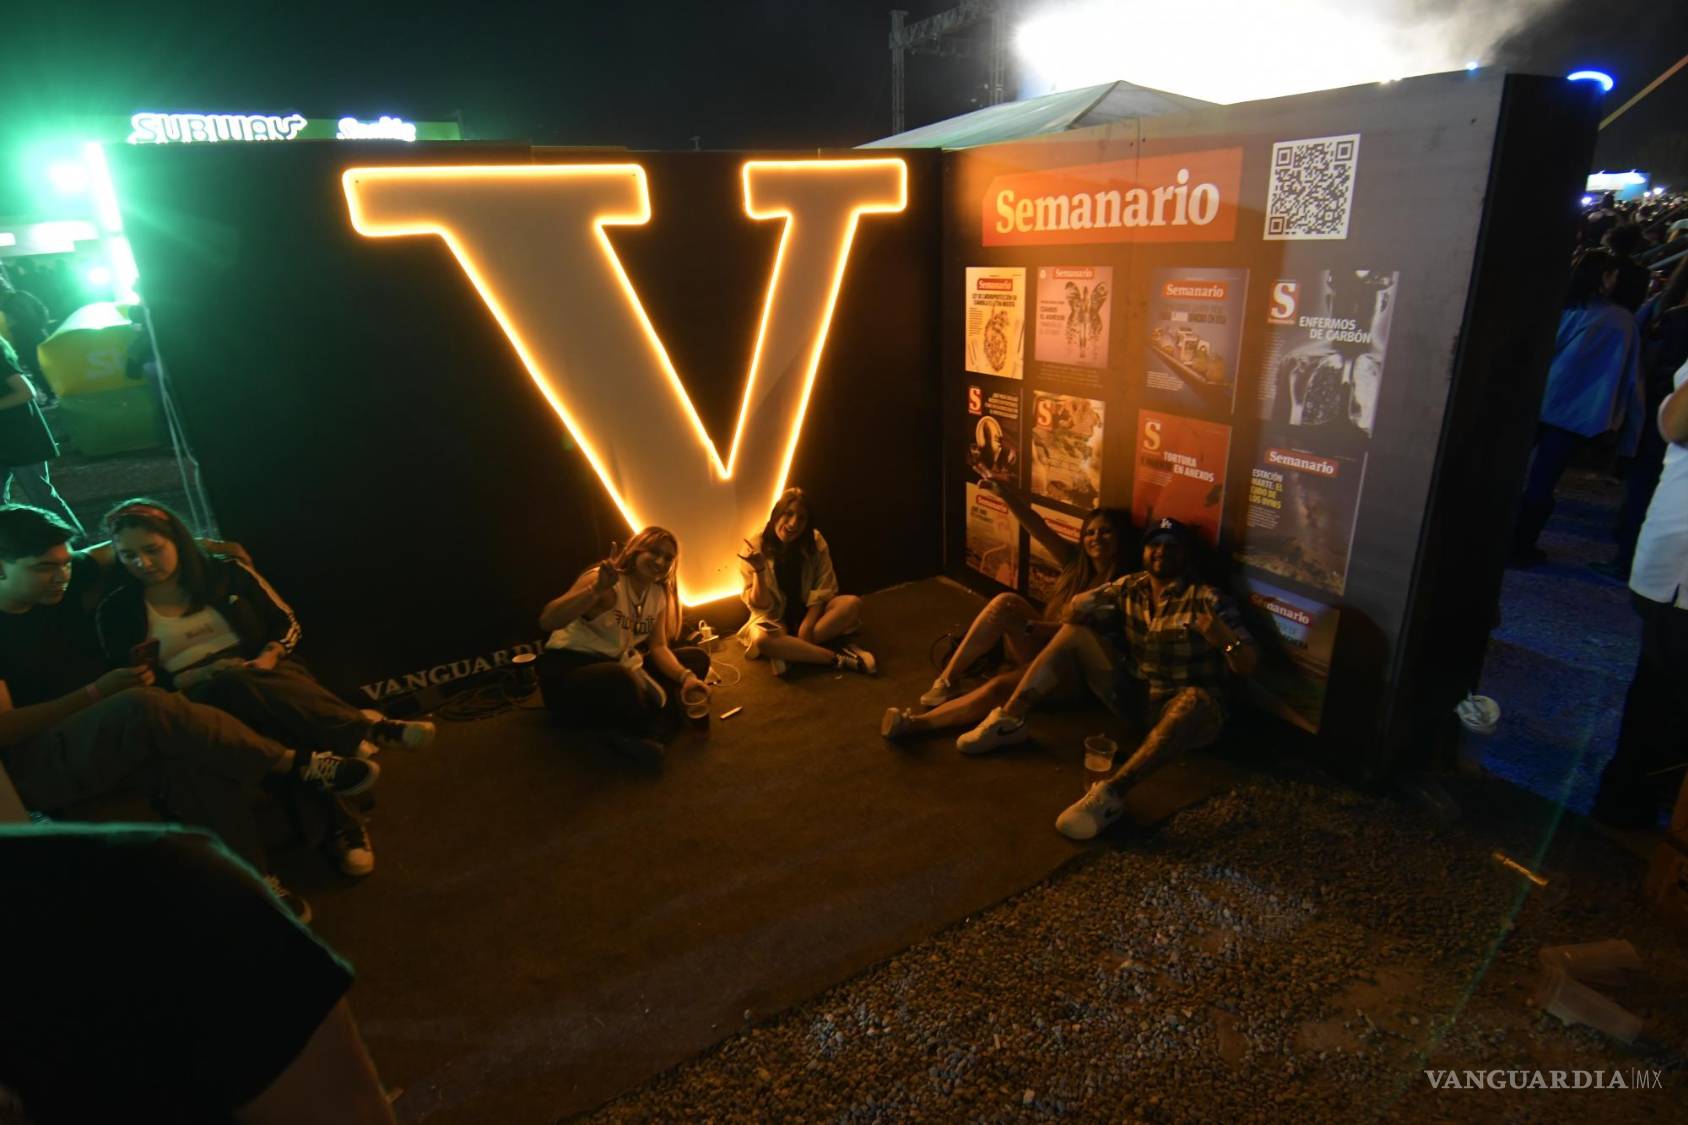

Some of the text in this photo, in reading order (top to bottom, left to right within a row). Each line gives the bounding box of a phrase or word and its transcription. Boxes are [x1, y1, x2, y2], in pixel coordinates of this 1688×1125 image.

[128, 112, 308, 144] SUBWAY
[996, 168, 1220, 234] Semanario
[1166, 283, 1224, 297] Semanario
[1271, 283, 1296, 318] S
[1299, 316, 1356, 330] ENFERMOS
[1310, 329, 1371, 343] DE CARBÓN
[342, 158, 909, 608] V
[969, 388, 981, 411] S
[1038, 399, 1051, 426] S
[1144, 421, 1161, 450] S
[1164, 451, 1197, 467] TORTURA
[1270, 451, 1334, 475] Semanario
[1174, 464, 1184, 474] EN
[1184, 467, 1215, 482] ANEXOS
[360, 640, 545, 701] VANGUARDI
